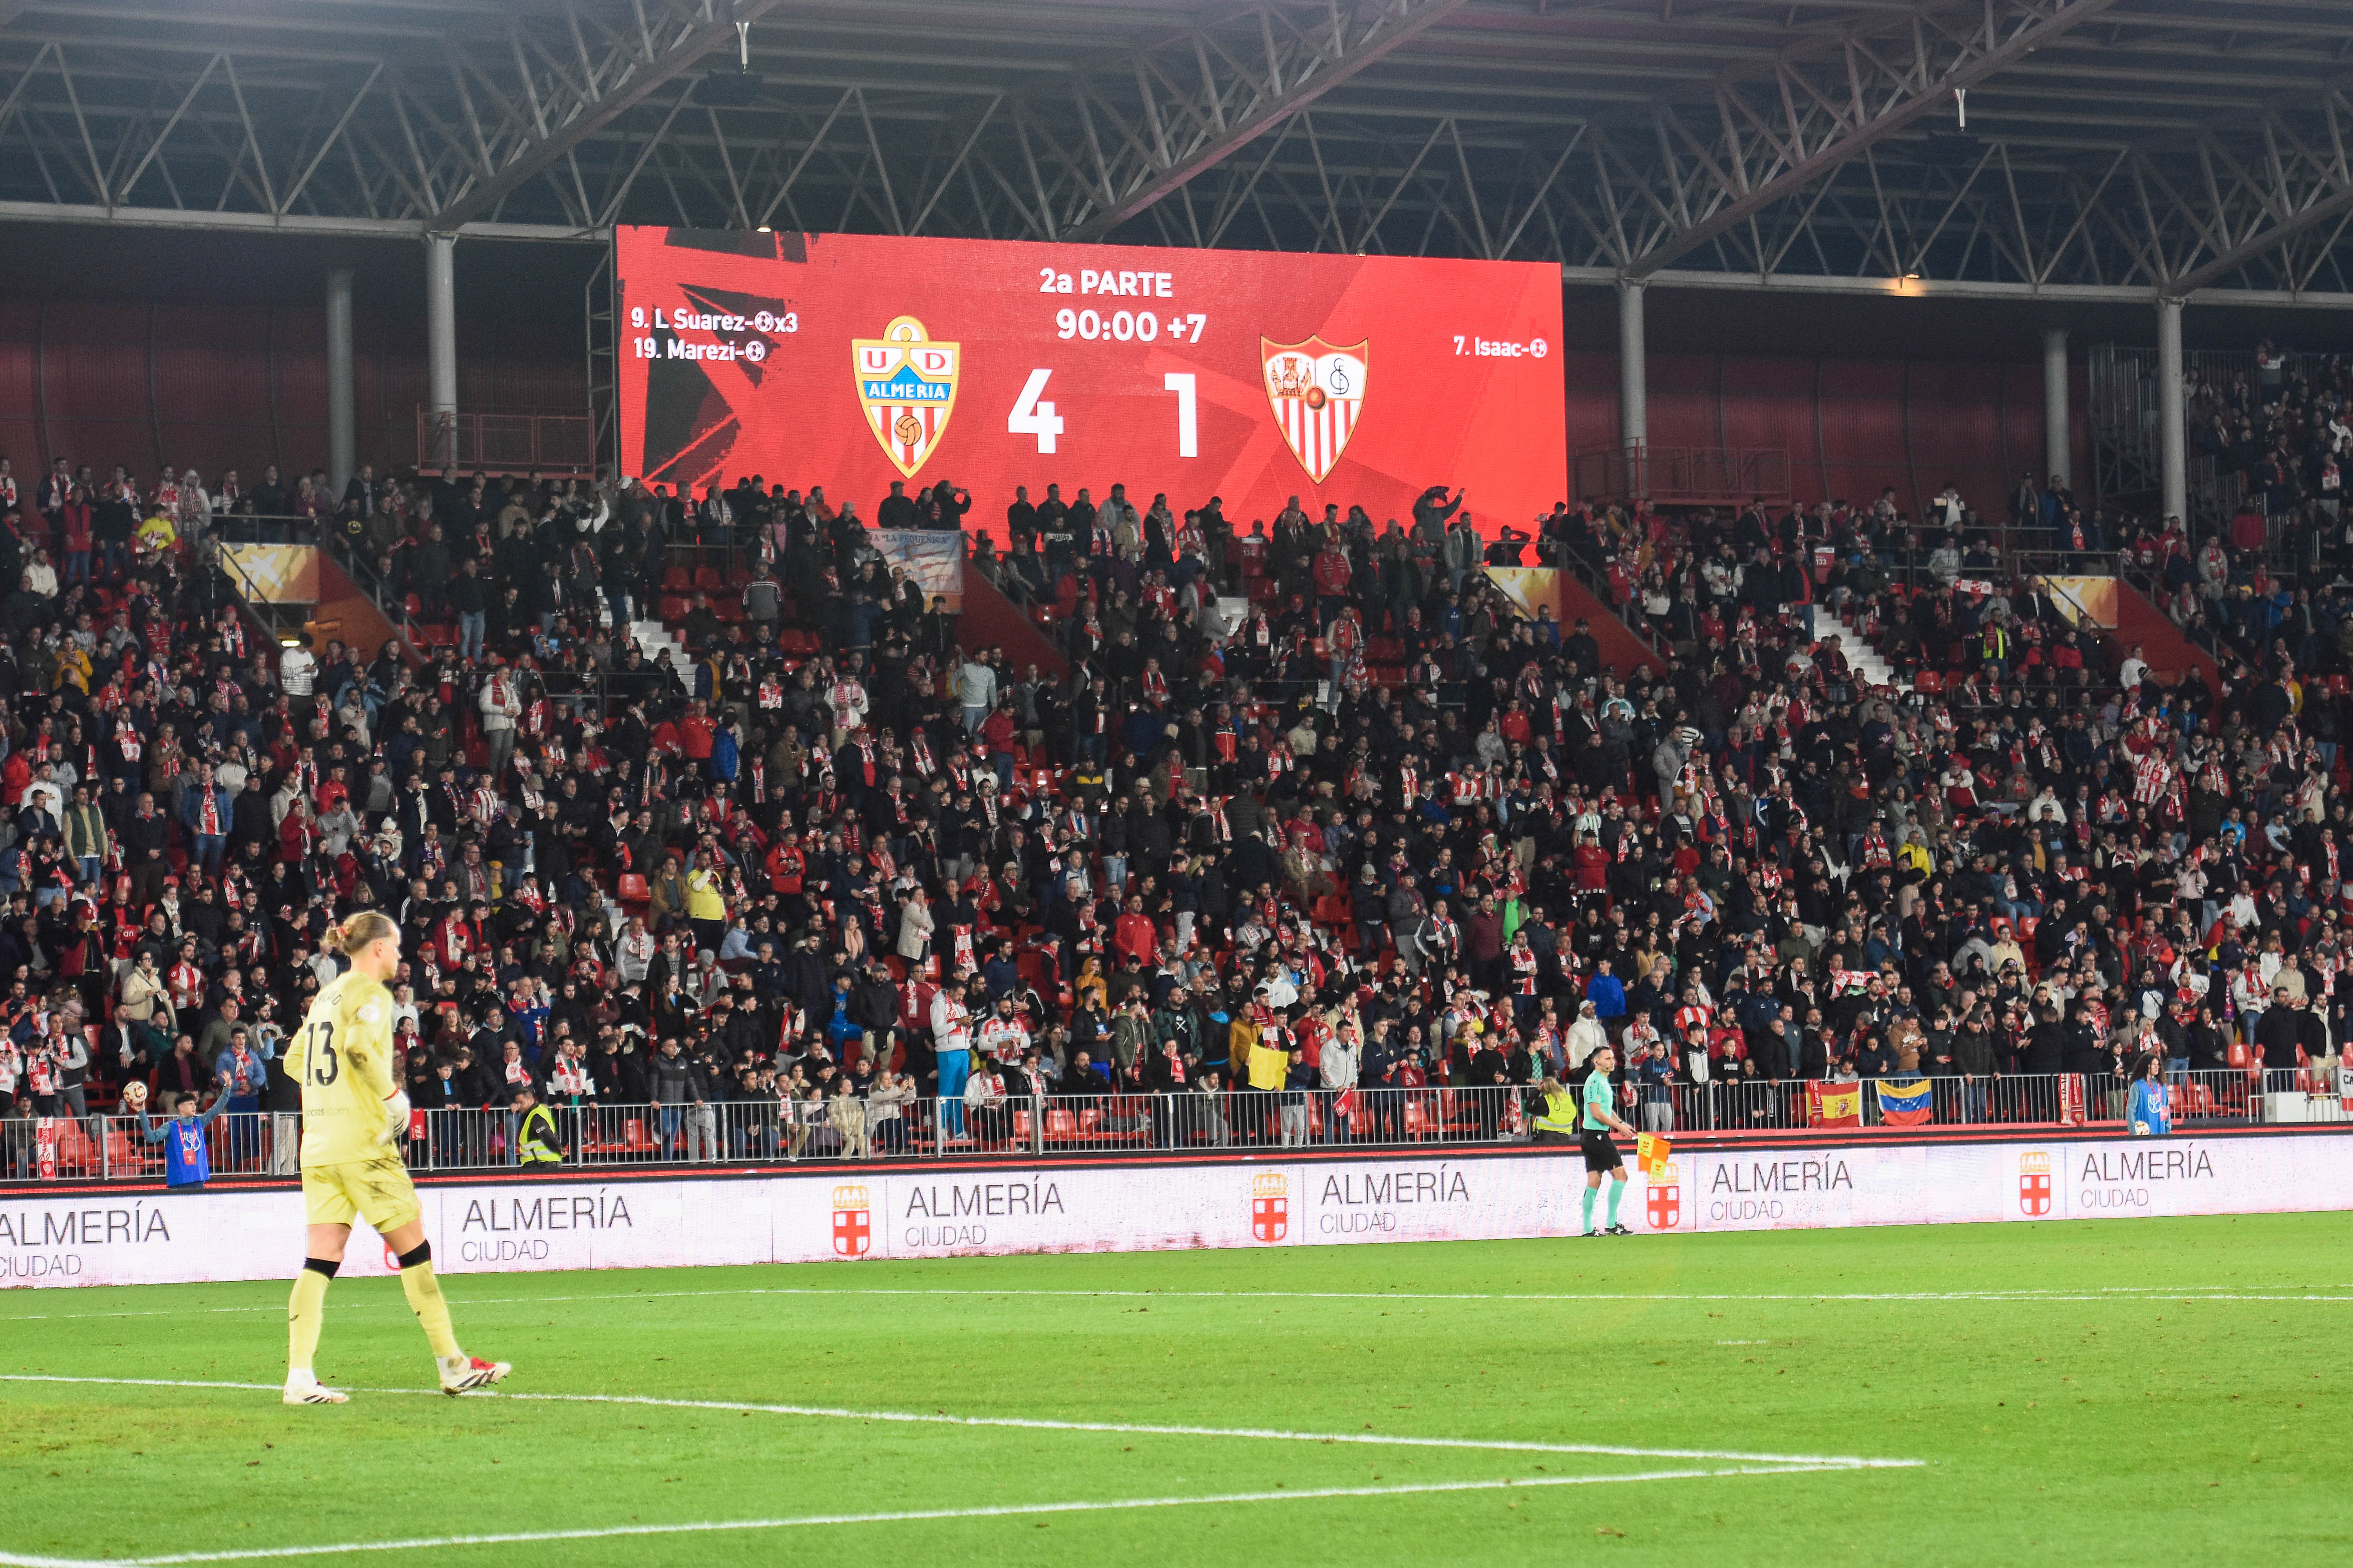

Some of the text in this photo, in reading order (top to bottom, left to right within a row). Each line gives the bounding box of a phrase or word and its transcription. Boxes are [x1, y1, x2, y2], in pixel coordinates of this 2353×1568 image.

[1039, 268, 1173, 297] 2a PARTE
[631, 306, 650, 328] 9.
[1056, 308, 1207, 344] 90:00 +7
[633, 337, 662, 359] 19.
[1453, 335, 1469, 356] 7.
[867, 350, 946, 370] U D
[869, 383, 946, 399] ALMERIA
[1008, 368, 1064, 454] 4
[1164, 373, 1198, 457] 1
[305, 1021, 338, 1087] 13
[1711, 1154, 1853, 1194] ALMERÍA
[2082, 1143, 2214, 1182] ALMERÍA
[906, 1175, 1064, 1218] ALMERÍA
[1321, 1163, 1469, 1206] ALMERÍA
[462, 1188, 633, 1232] ALMERÍA
[1711, 1200, 1783, 1220] CIUDAD
[2081, 1189, 2149, 1208] CIUDAD
[1320, 1212, 1396, 1233] CIUDAD
[906, 1225, 986, 1247] CIUDAD
[462, 1239, 549, 1262] CIUDAD
